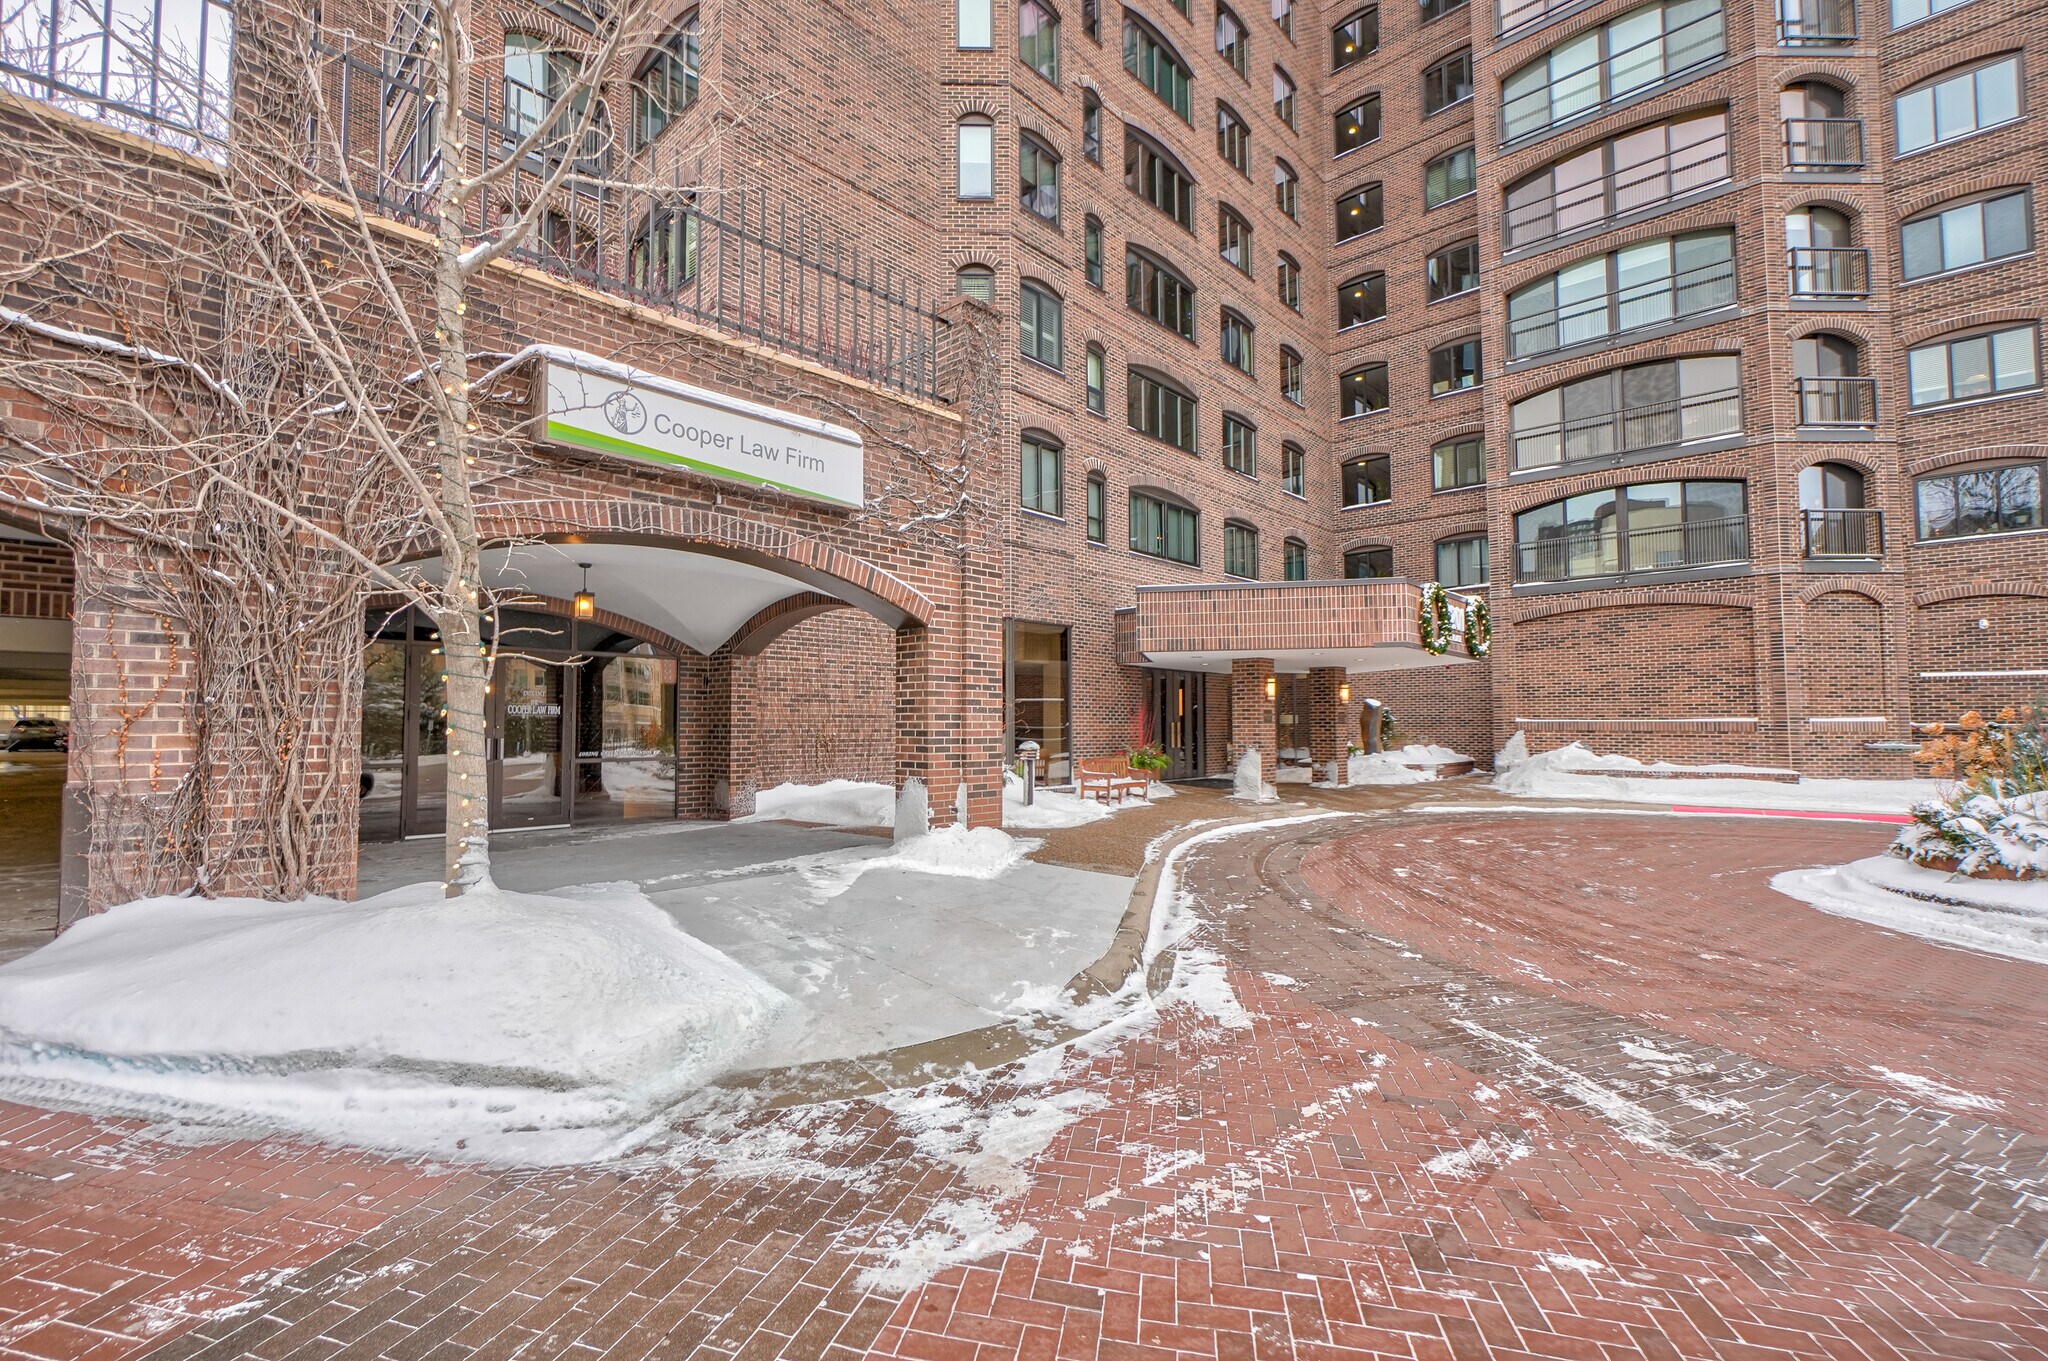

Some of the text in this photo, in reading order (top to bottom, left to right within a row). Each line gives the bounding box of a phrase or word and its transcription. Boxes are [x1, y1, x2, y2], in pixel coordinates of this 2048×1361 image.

[654, 413, 825, 473] Cooper Law Firm
[508, 705, 561, 716] COOPER LAW FIRM
